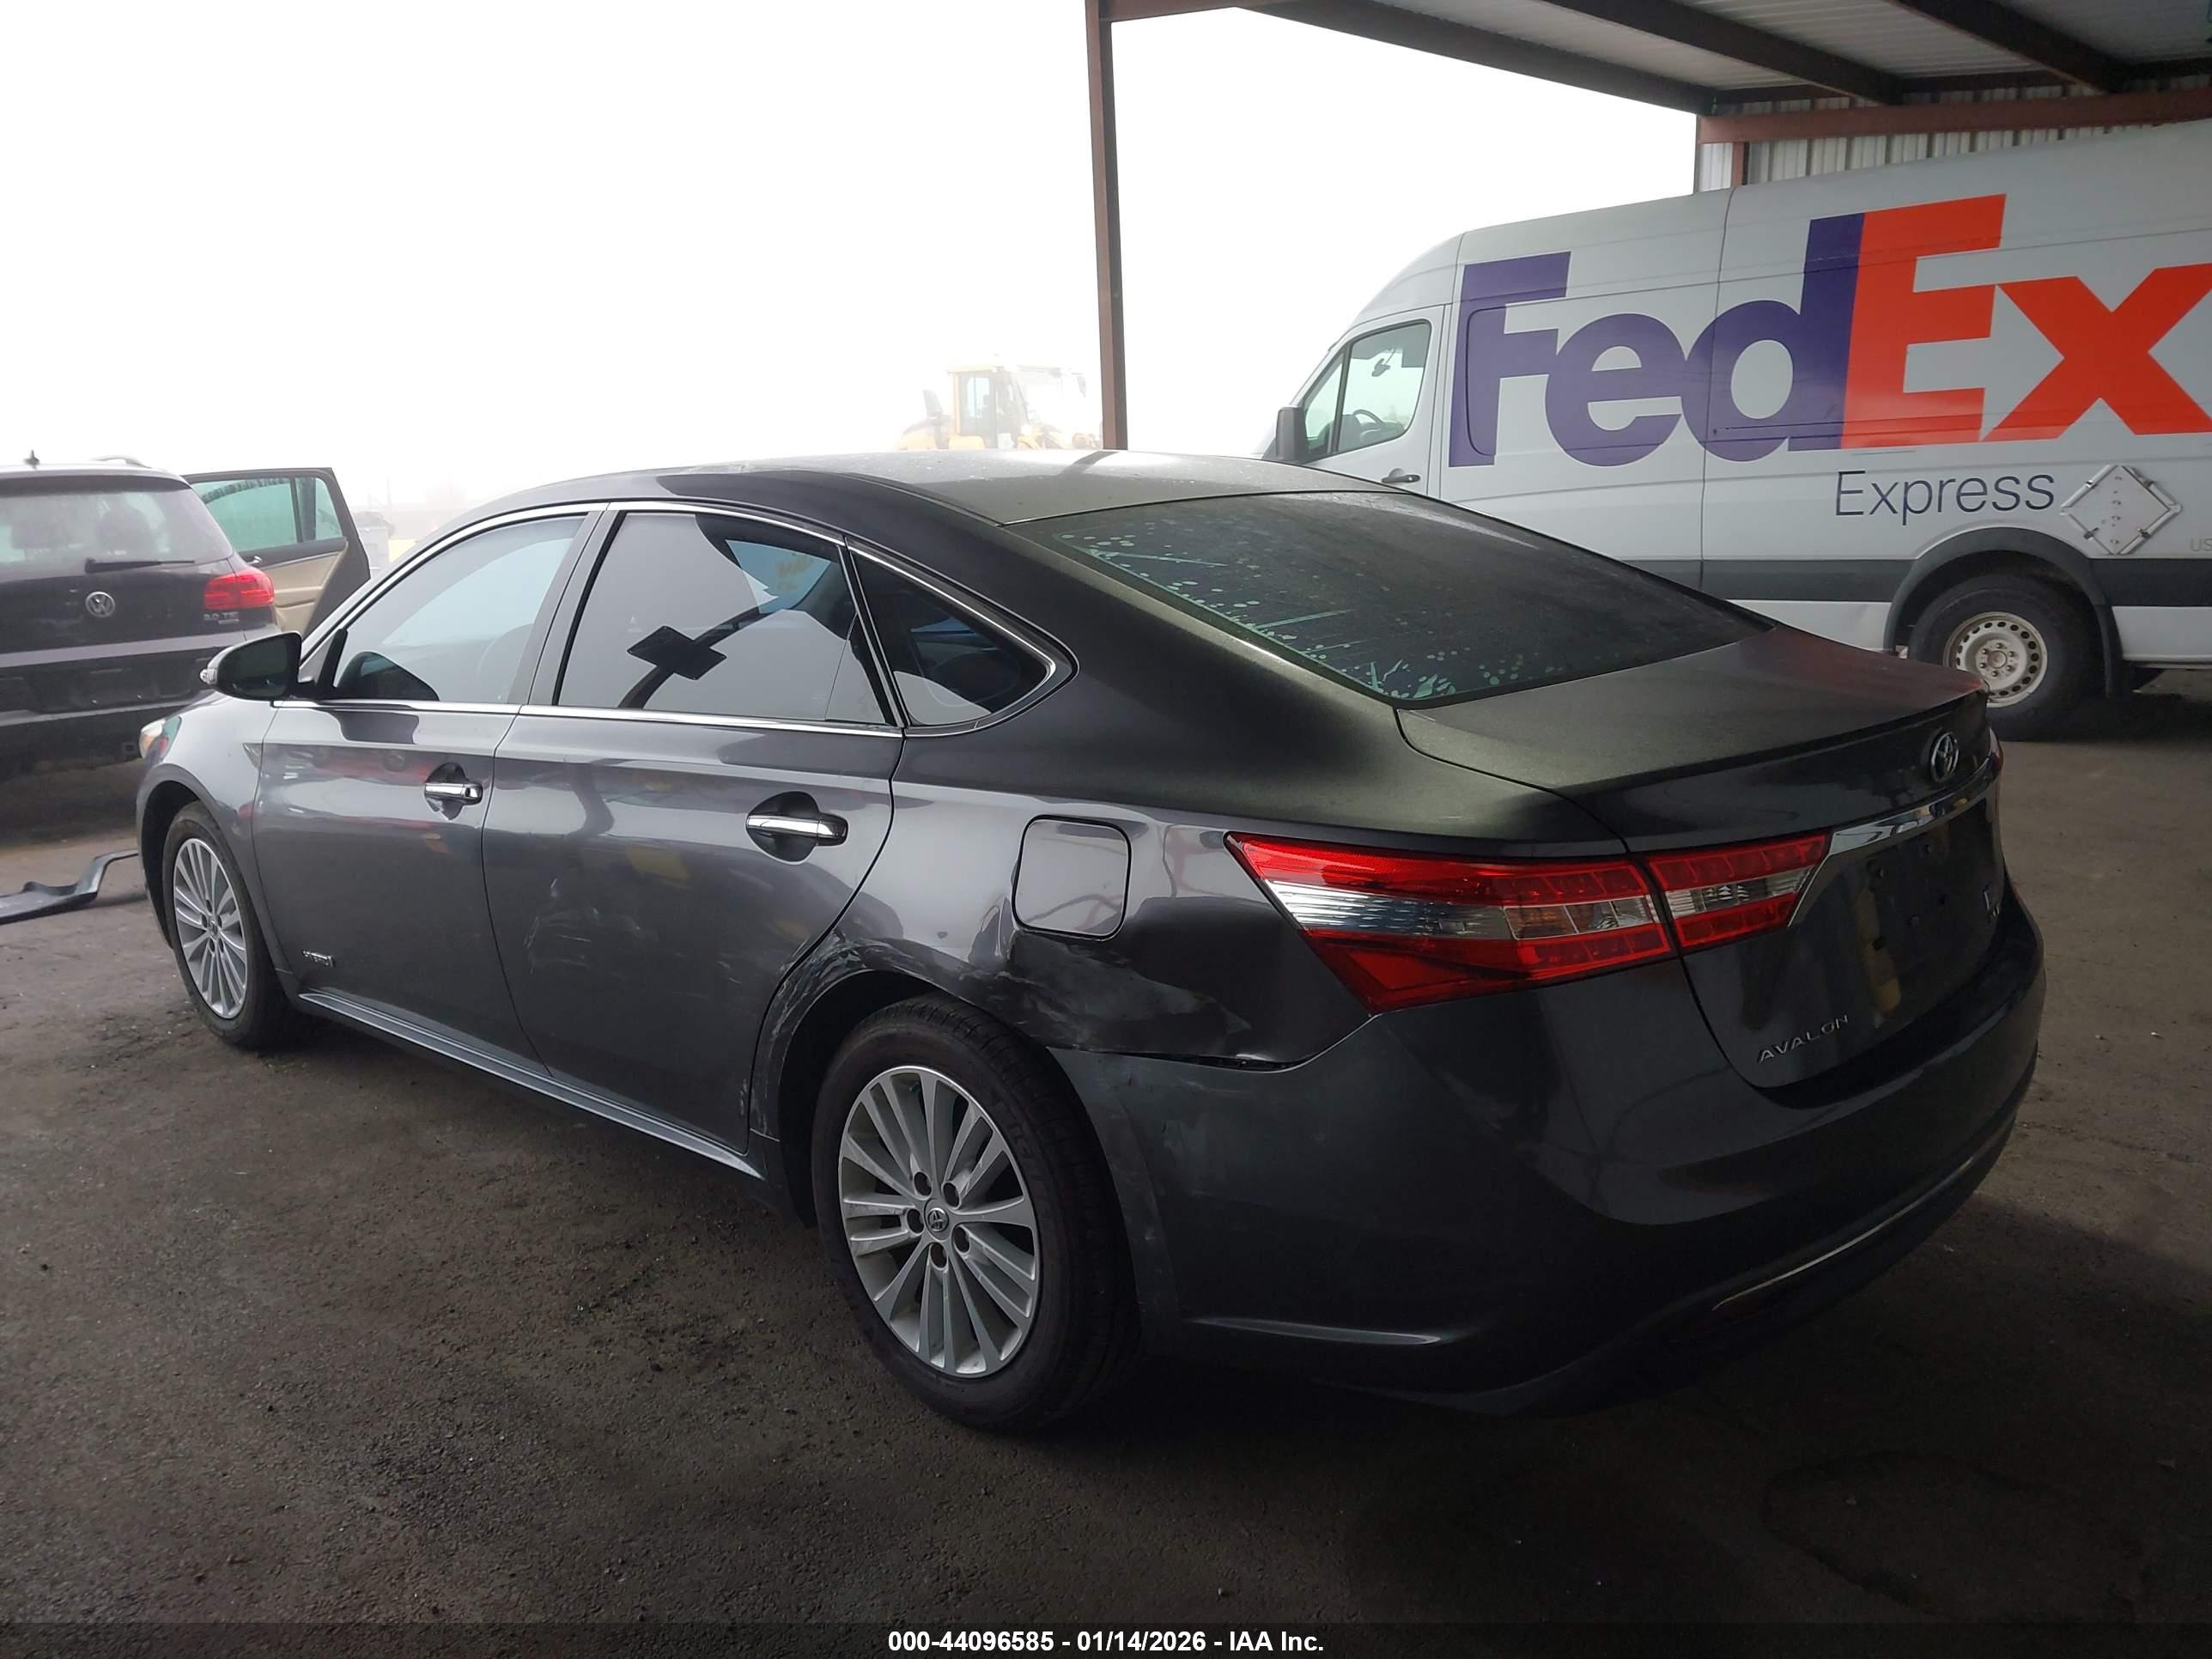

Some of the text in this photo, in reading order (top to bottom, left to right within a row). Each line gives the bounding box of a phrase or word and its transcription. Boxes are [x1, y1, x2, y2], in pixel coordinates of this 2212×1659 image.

[1449, 194, 2212, 466] FedEx
[1836, 469, 2055, 526] Express
[1759, 1014, 1849, 1063] AVALON
